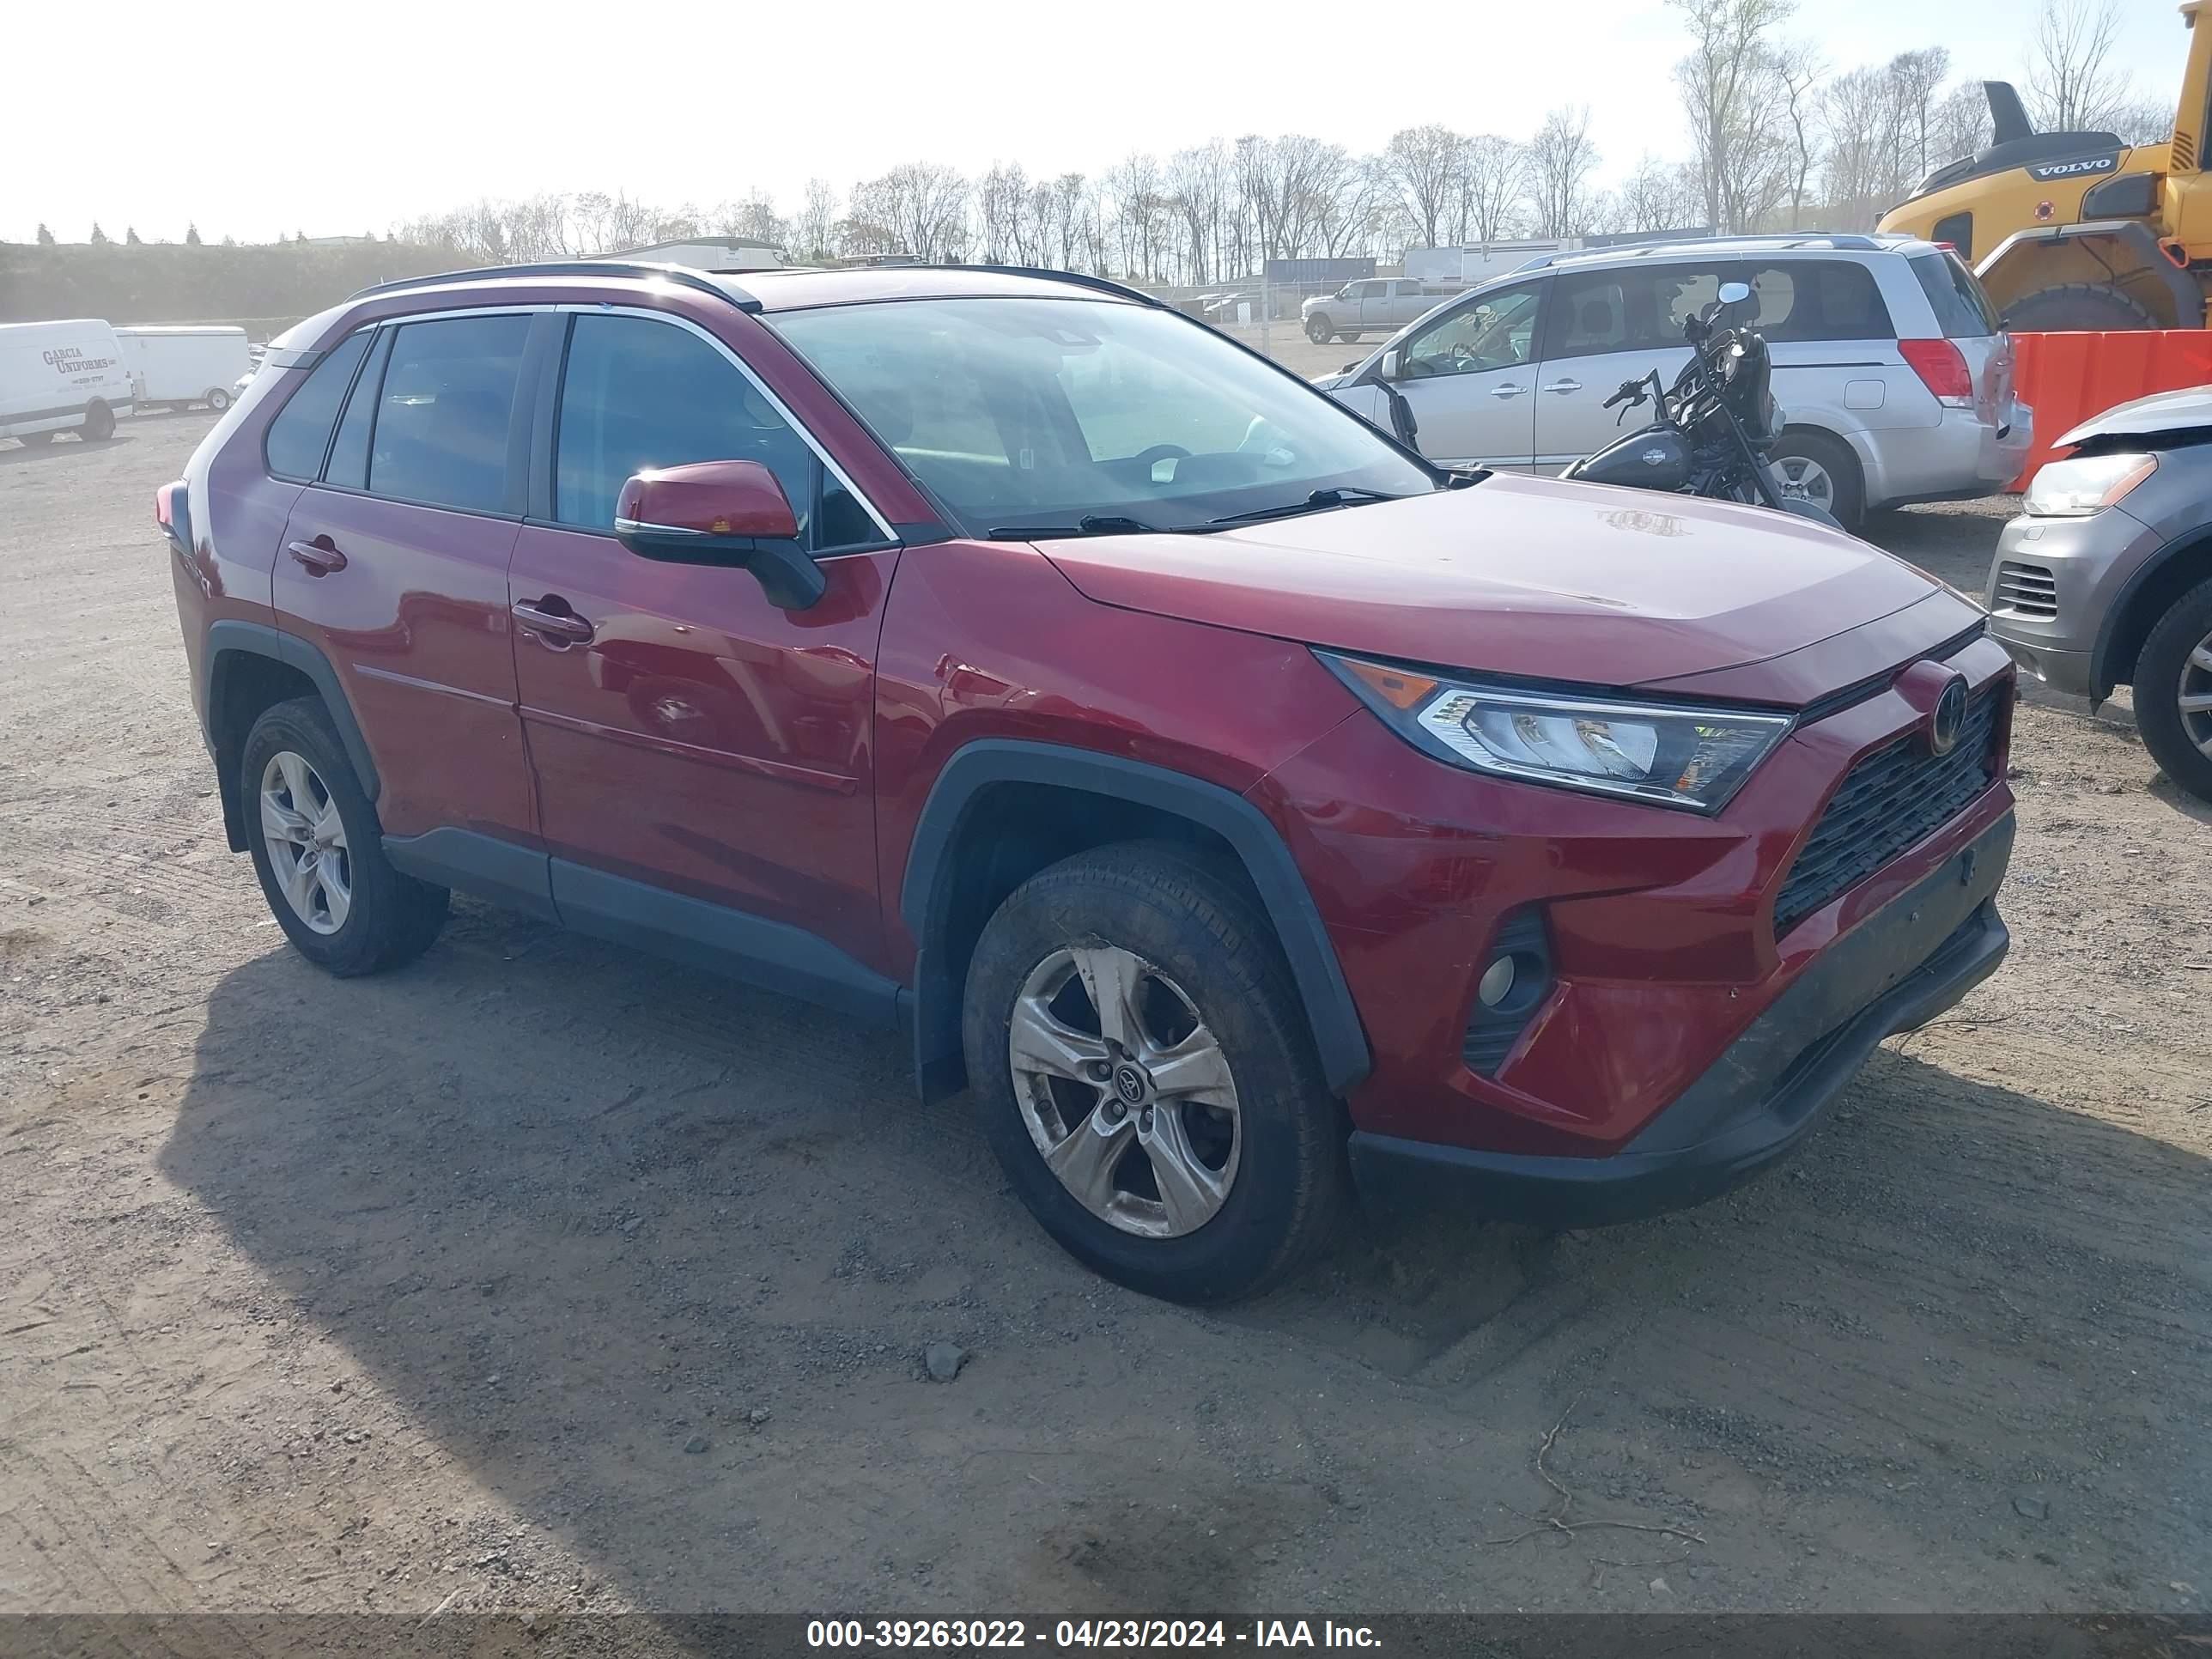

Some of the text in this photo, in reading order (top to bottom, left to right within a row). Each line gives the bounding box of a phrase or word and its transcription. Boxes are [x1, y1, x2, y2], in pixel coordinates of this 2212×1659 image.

[2038, 159, 2112, 177] VOLVO
[42, 347, 83, 366] GARCIA
[54, 358, 109, 374] UNIFORMS
